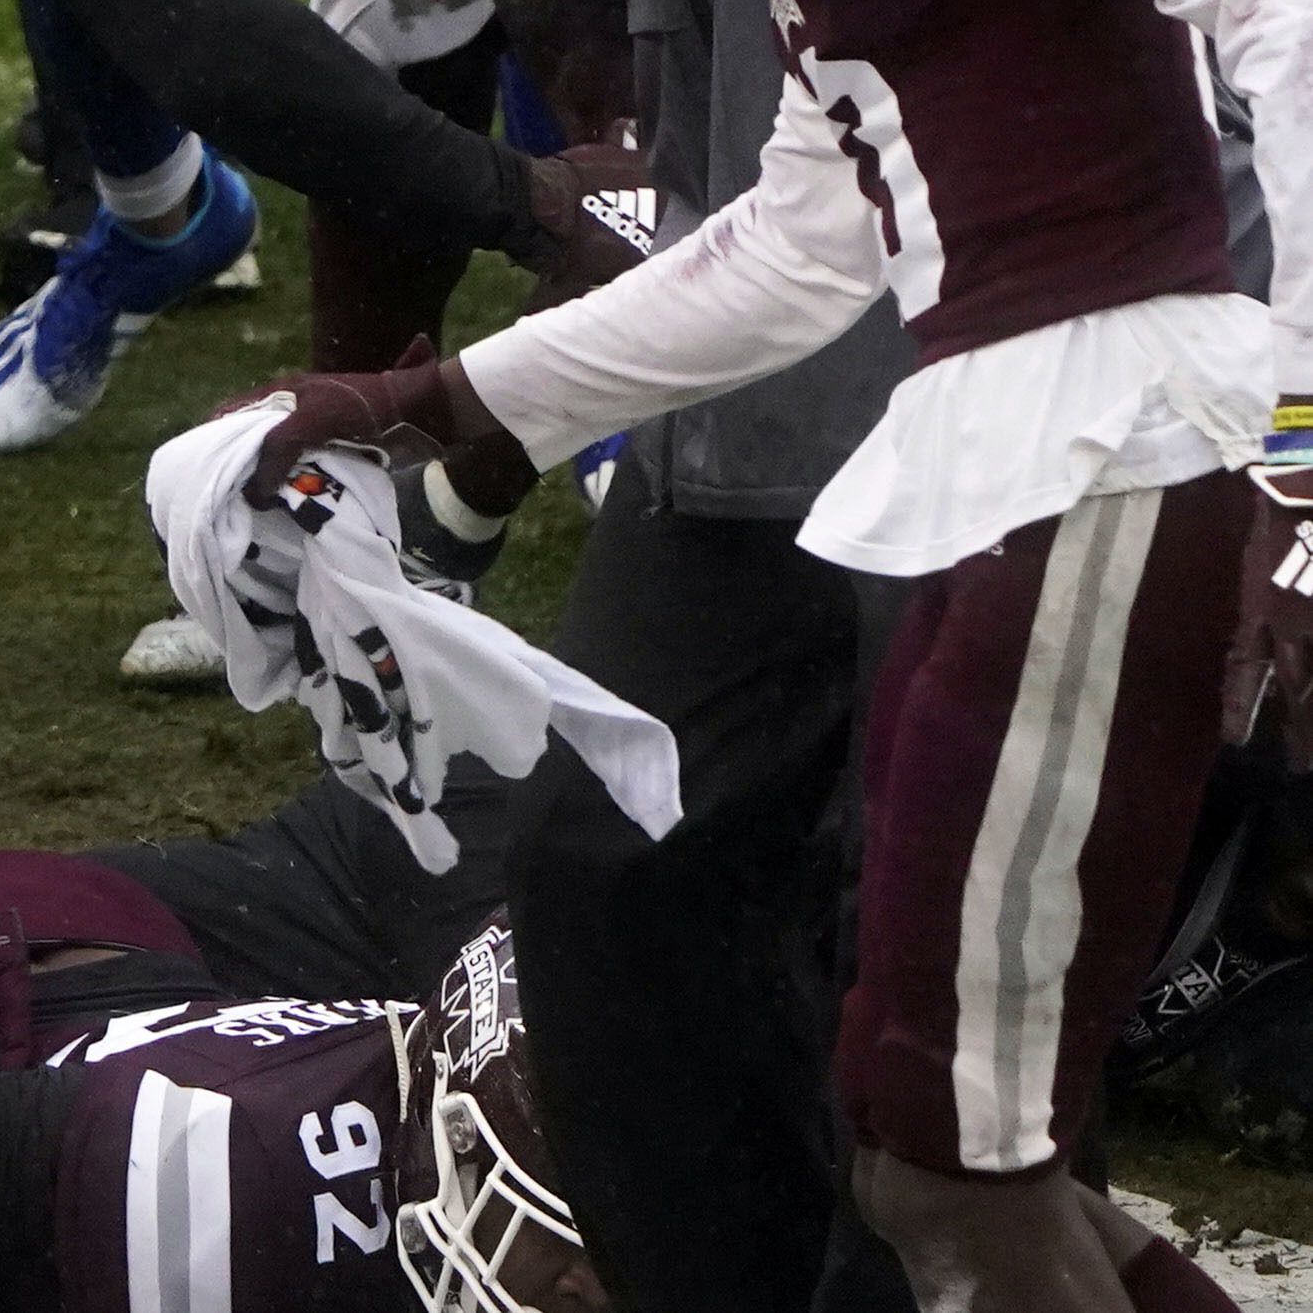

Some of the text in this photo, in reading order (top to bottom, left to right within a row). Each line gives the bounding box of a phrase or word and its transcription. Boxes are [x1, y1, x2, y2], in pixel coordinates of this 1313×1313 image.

[581, 194, 654, 256] adidas
[469, 949, 495, 1037] STATE
[298, 1100, 391, 1264] 92
